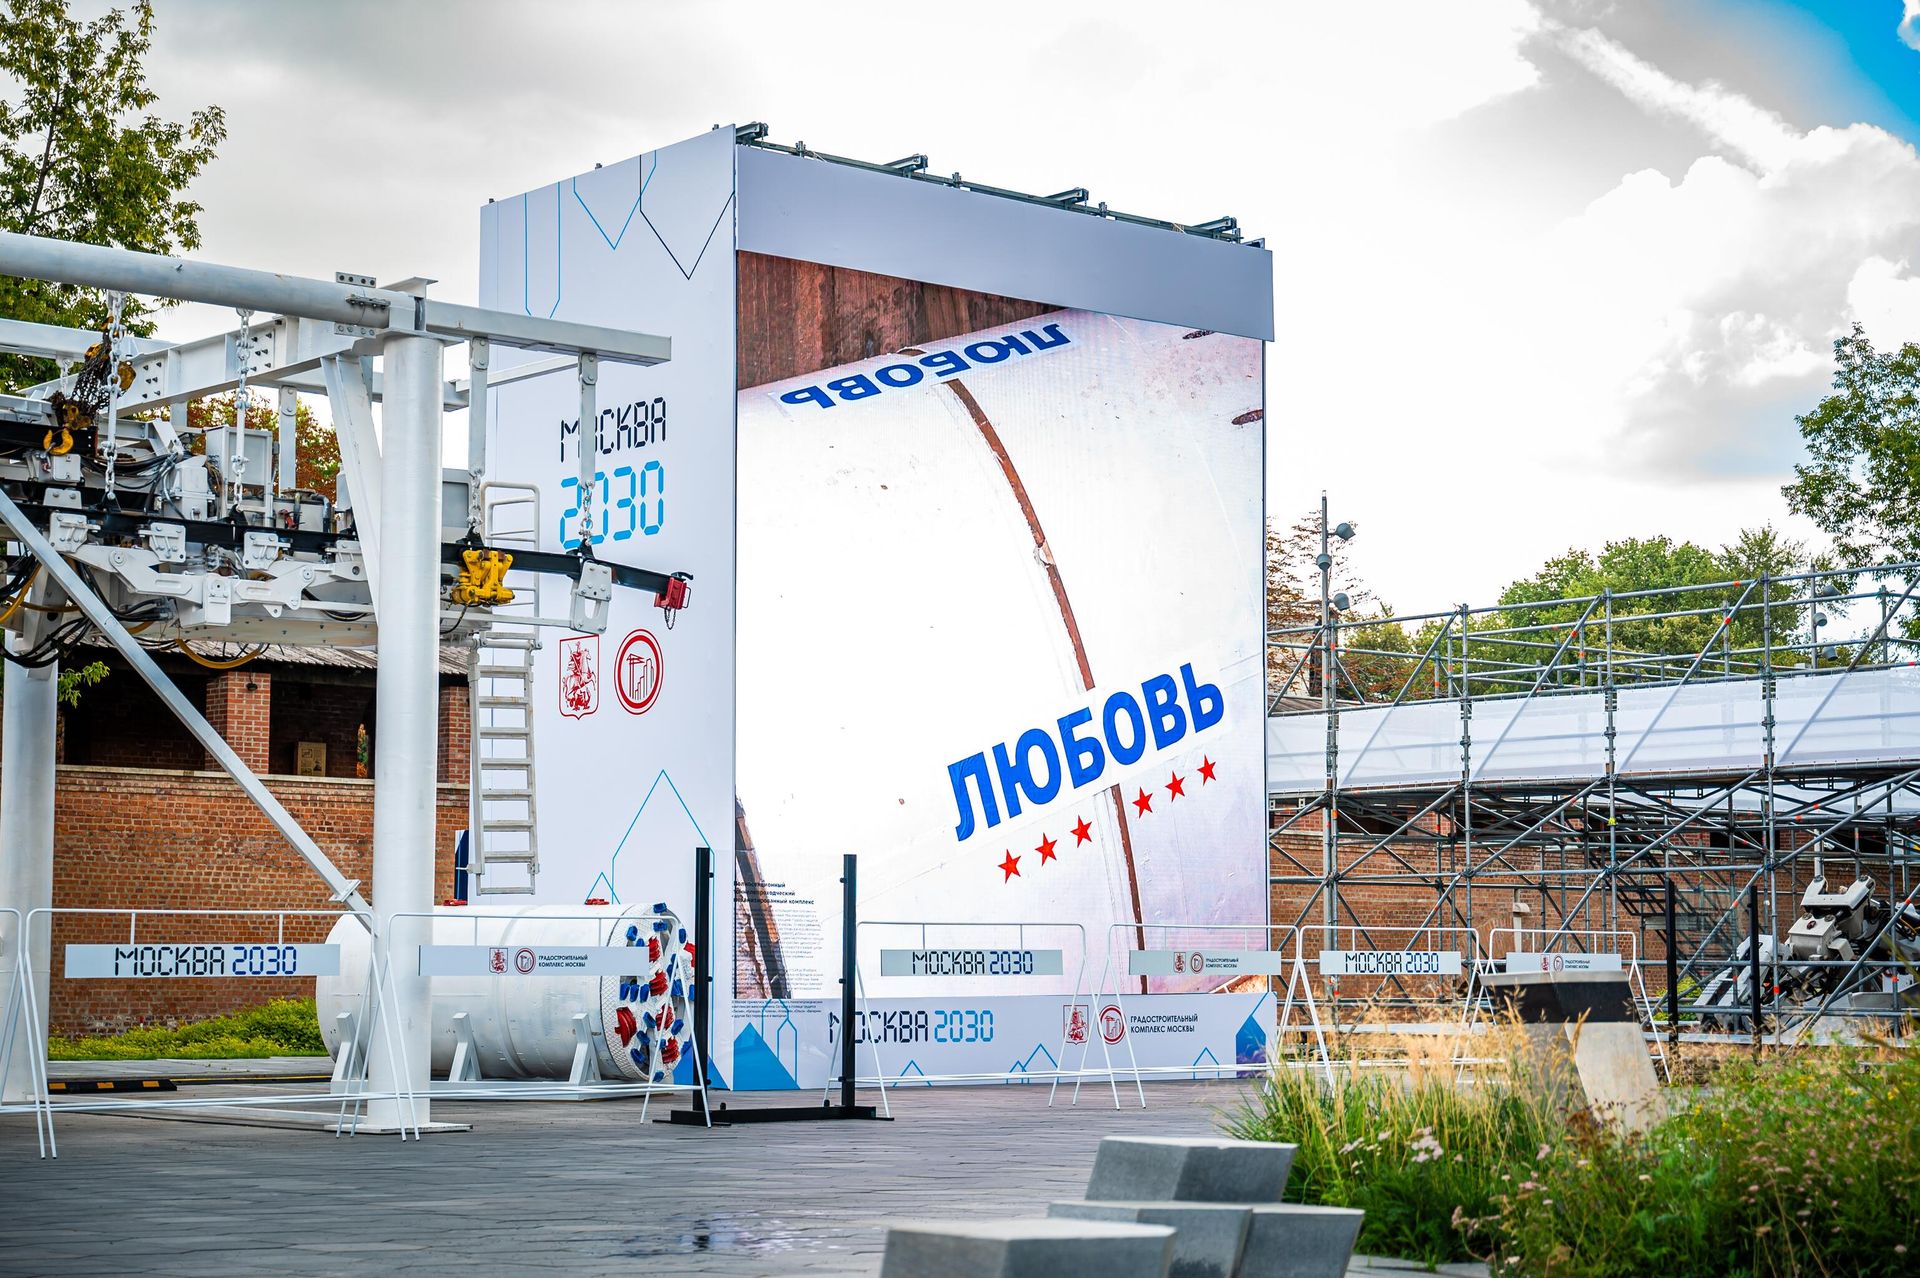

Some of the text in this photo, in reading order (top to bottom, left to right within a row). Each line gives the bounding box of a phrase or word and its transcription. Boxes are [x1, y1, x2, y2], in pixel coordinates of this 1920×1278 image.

[780, 323, 1072, 409] ЛЮБОВЬ
[560, 396, 666, 463] МСКВА
[559, 460, 665, 550] 2030
[947, 662, 1225, 842] ЛЮБОВЬ
[115, 946, 297, 976] МОСКВА 2030
[912, 951, 1033, 975] МОСКВА 2030
[1345, 952, 1439, 973] МОСКВА 2030
[934, 1010, 993, 1043] 2030
[1130, 1014, 1198, 1023] ГРАДОСТРОИТЕЛЬНЫЙ
[1130, 1025, 1165, 1033] КОМПЛЕКС
